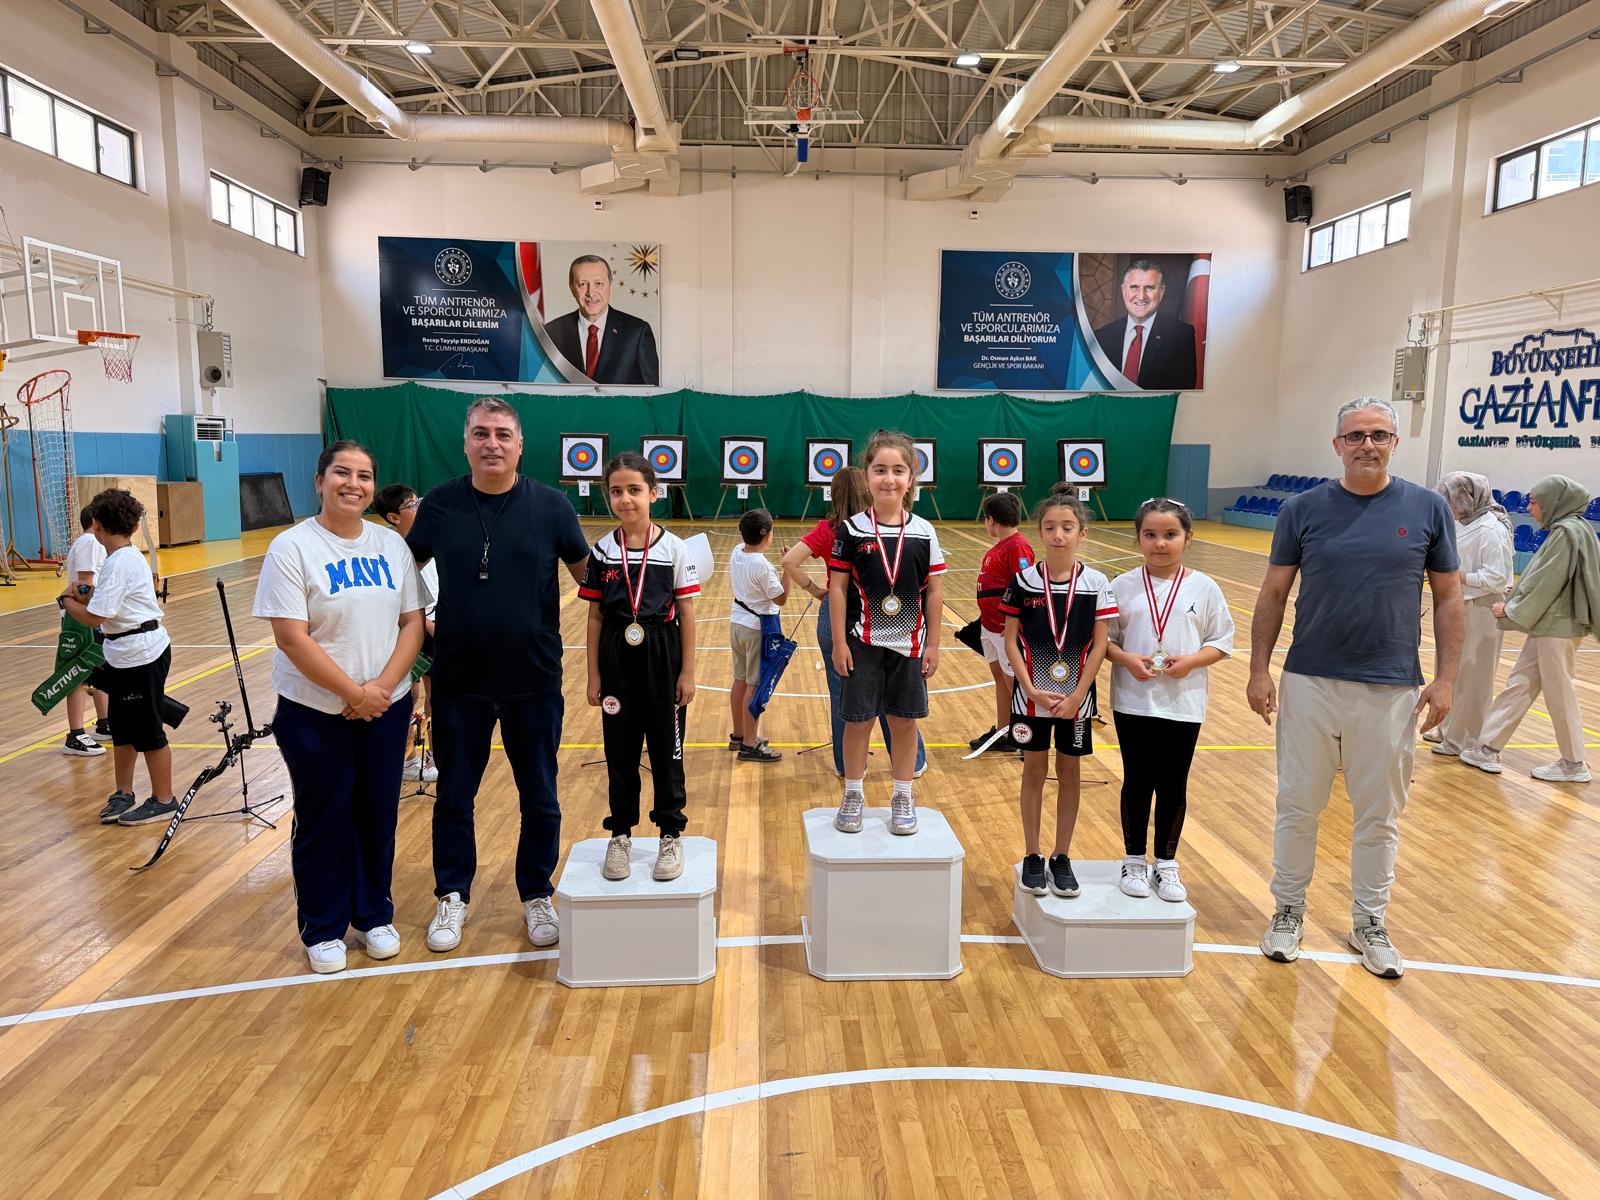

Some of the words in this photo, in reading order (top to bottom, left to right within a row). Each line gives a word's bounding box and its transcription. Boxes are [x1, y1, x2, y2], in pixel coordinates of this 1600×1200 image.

[414, 294, 437, 305] TÜM
[440, 296, 496, 307] ANTRENÖR
[402, 306, 416, 316] VE
[418, 306, 508, 318] SPORCULARIMIZA
[972, 311, 995, 322] TÜM
[996, 312, 1050, 323] ANTRENÖR
[411, 318, 461, 329] BAŞARILAR
[463, 318, 499, 329] DİLERİM
[960, 323, 973, 333] VE
[975, 323, 1060, 334] SPORCULARIMIZA
[422, 337, 440, 345] Recep
[440, 337, 460, 345] Tayyip
[963, 334, 1009, 344] BAŞARILAR
[1011, 334, 1057, 343] DİLİYORUM
[435, 345, 489, 353] CUMHURBAŞKANI
[581, 485, 587, 494] 2
[739, 487, 746, 496] 4
[1081, 490, 1087, 499] 8
[46, 664, 82, 699] ACTIVE
[1073, 717, 1086, 749] Archery
[166, 788, 197, 838] VECTOR
